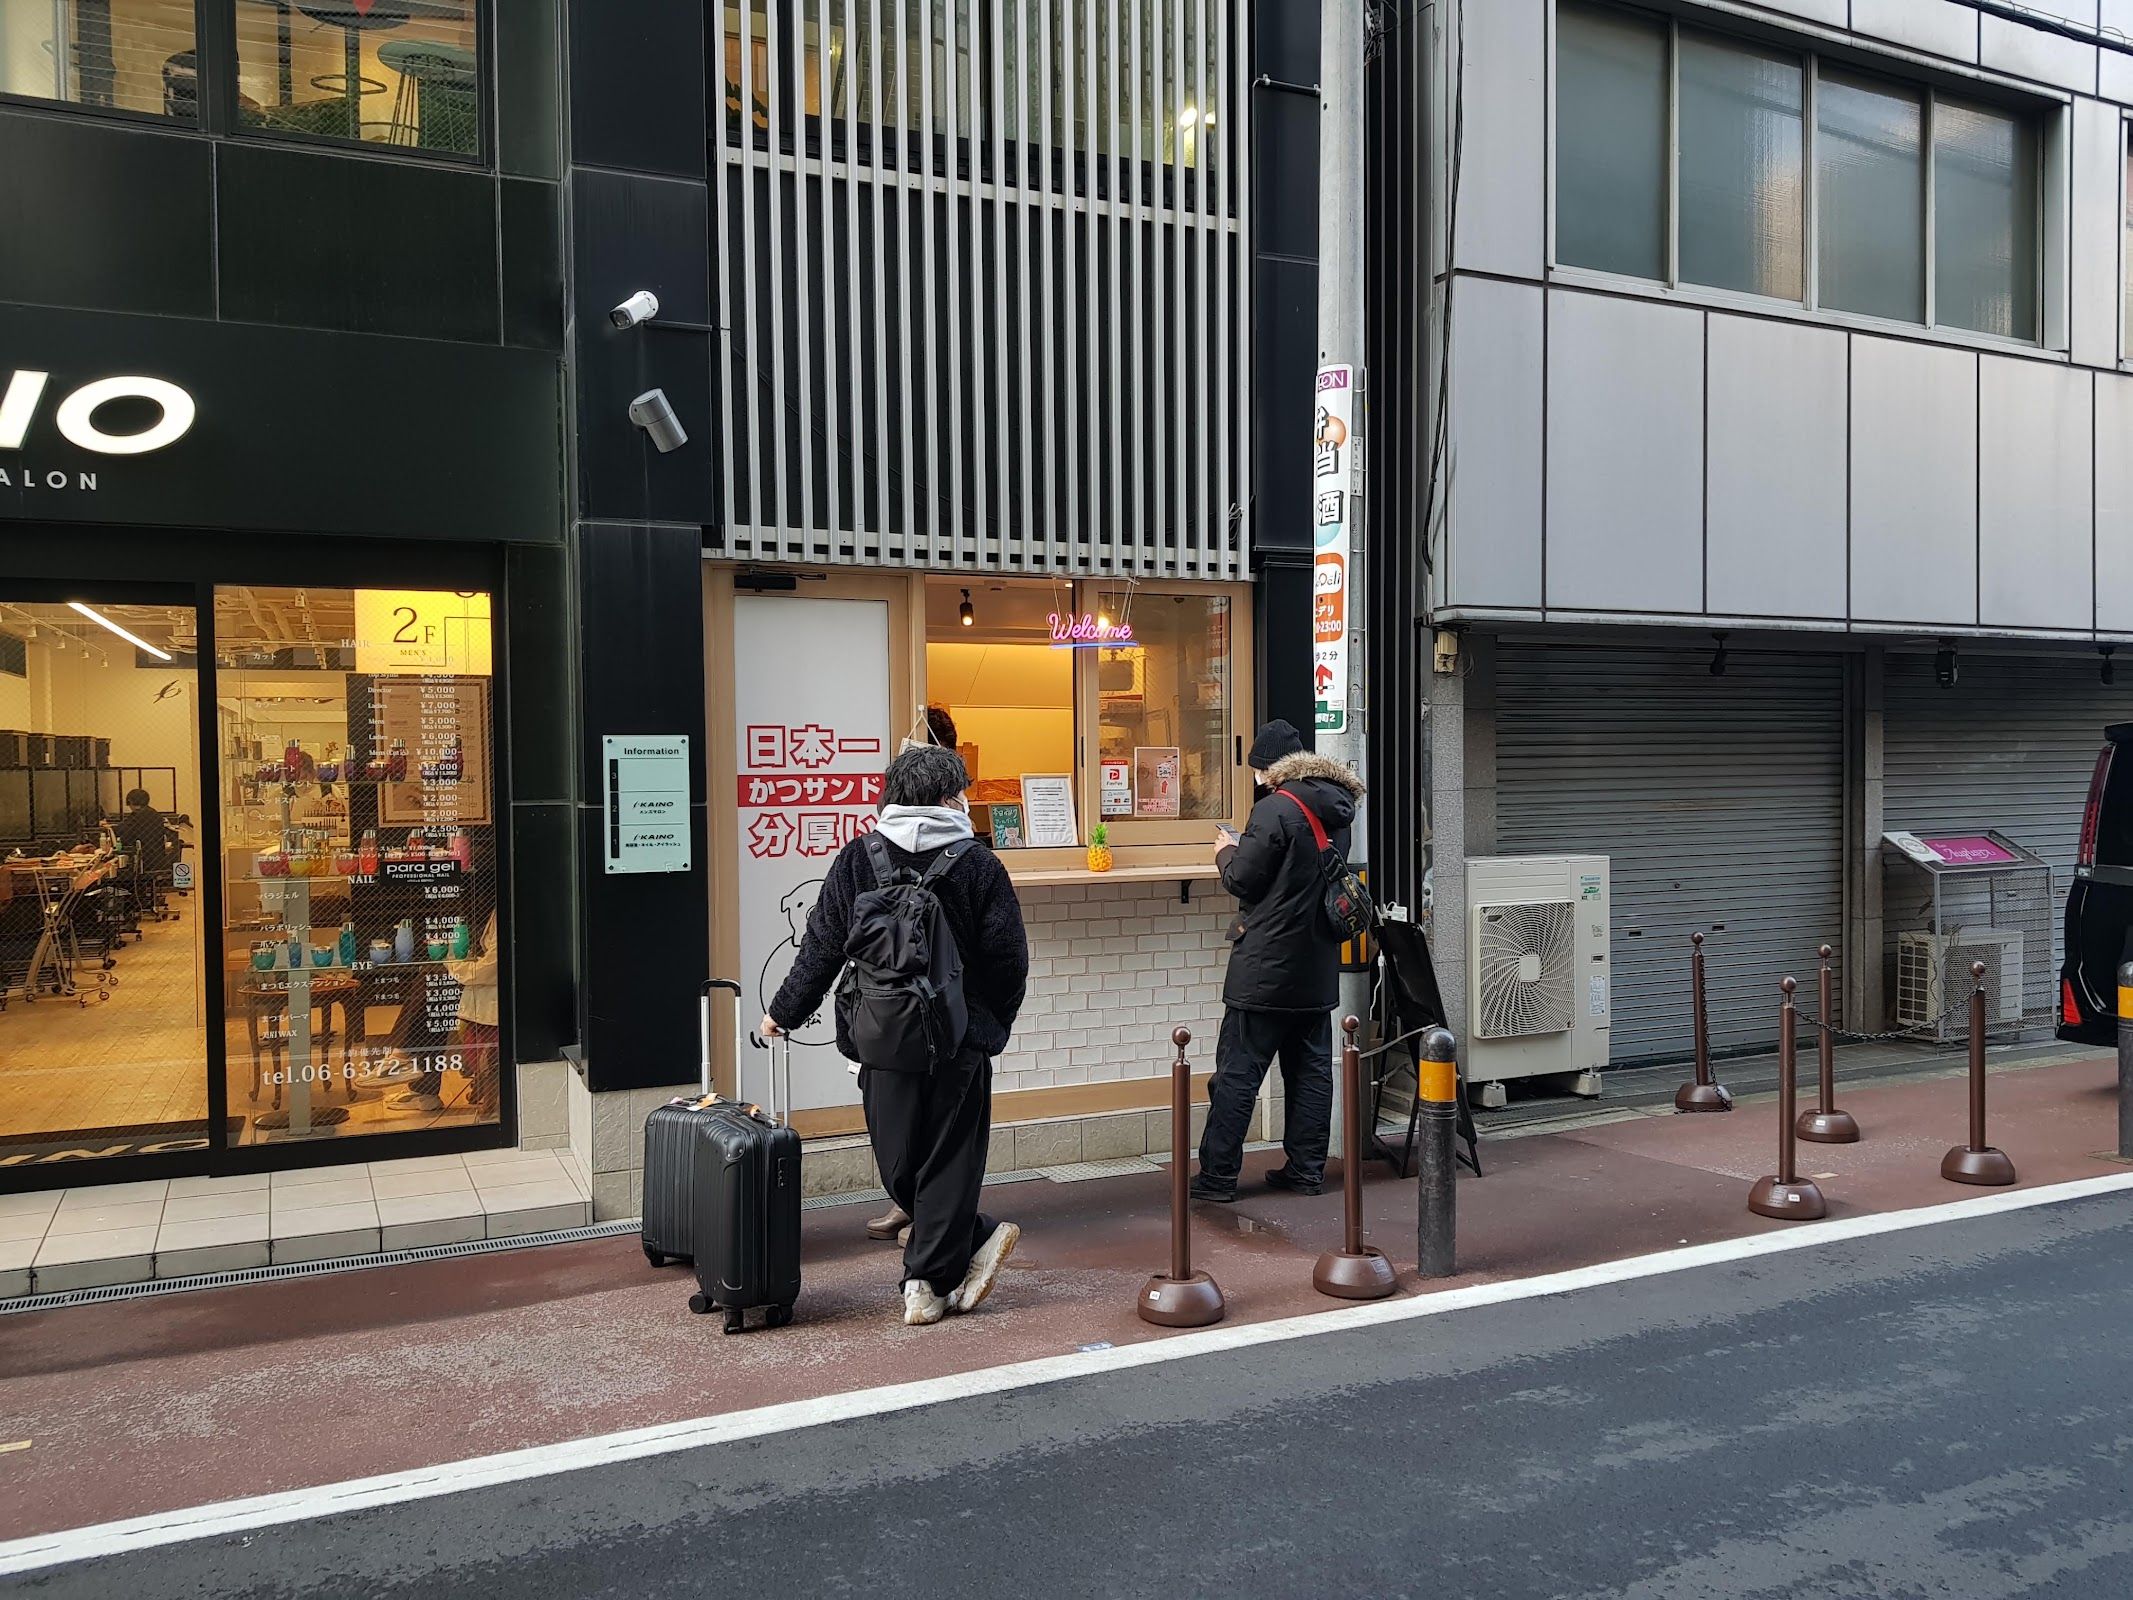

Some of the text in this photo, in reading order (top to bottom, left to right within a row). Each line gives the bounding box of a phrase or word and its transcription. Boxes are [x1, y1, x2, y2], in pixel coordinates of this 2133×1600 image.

[1046, 611, 1132, 640] Welcome
[420, 686, 455, 694] ¥5,000
[624, 747, 680, 755] Information
[747, 724, 880, 768] 日本一
[748, 776, 881, 804] かつサンド
[386, 861, 455, 875] para gel
[347, 875, 375, 884] NAIL
[352, 961, 373, 970] EYE
